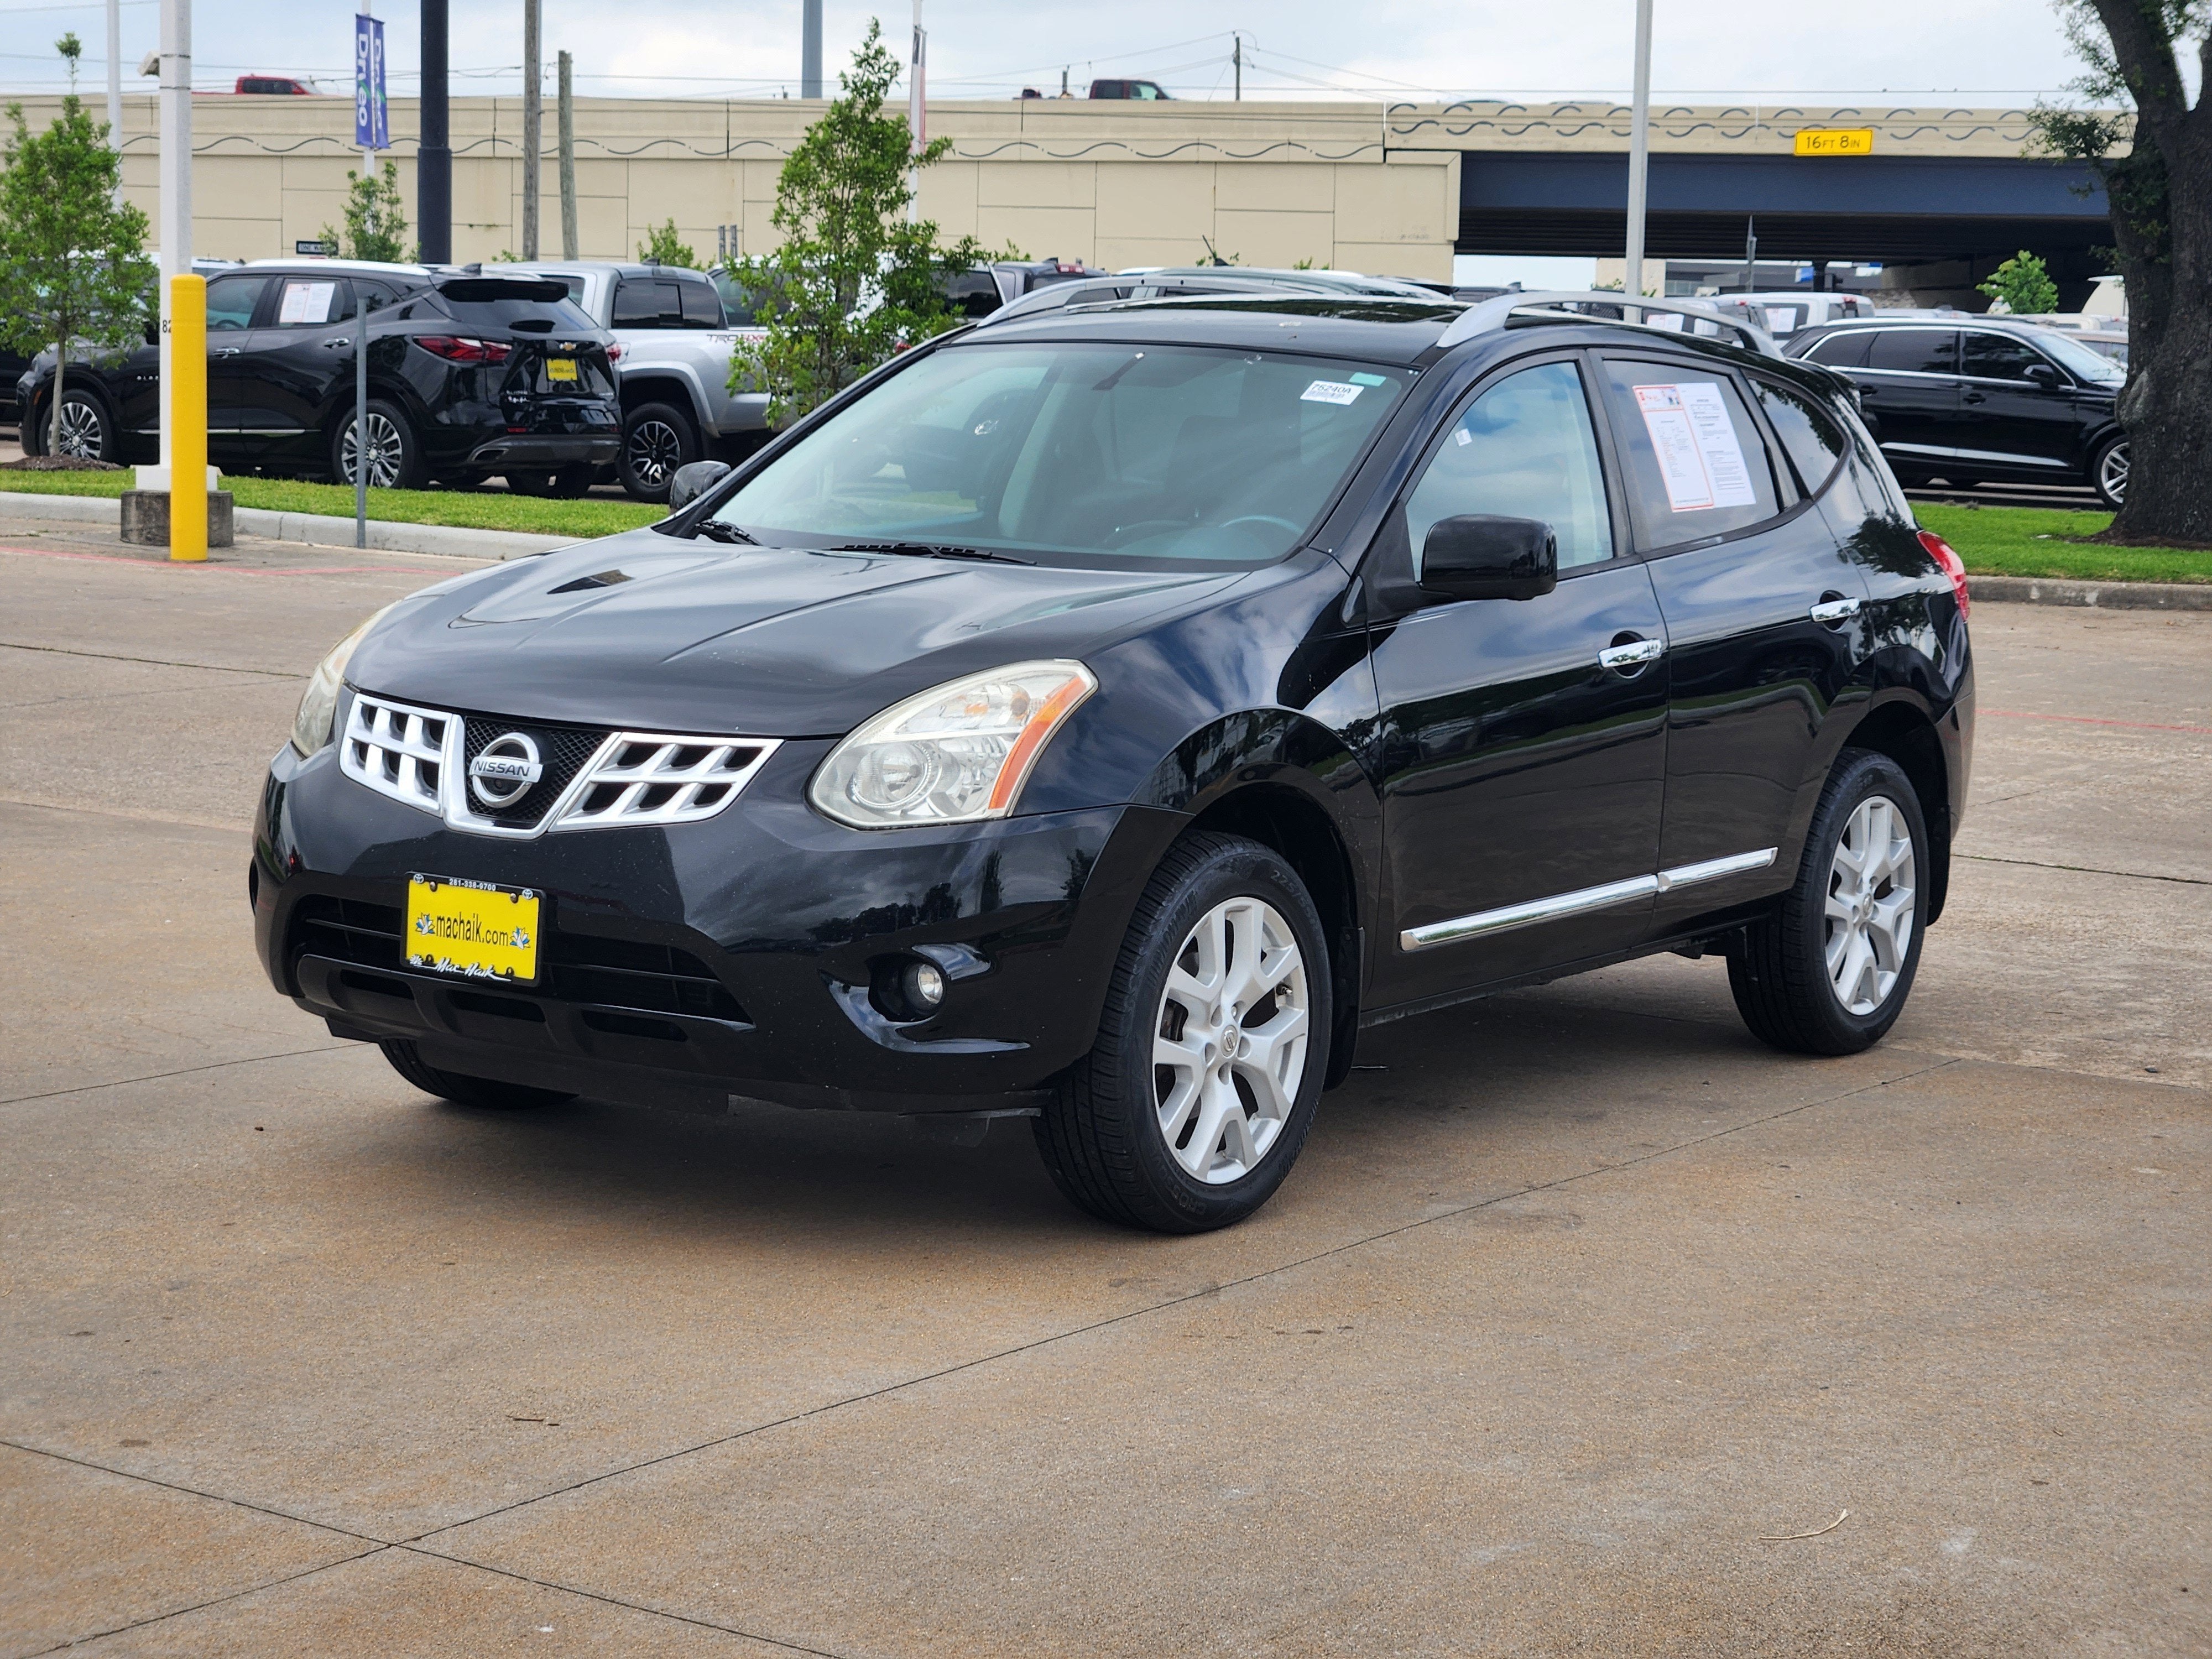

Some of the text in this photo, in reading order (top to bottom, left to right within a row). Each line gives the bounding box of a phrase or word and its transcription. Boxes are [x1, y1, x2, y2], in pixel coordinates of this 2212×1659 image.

[474, 761, 530, 776] NISSAN
[448, 878, 497, 891] 281-338-9700
[436, 911, 509, 947] machaik.com
[434, 957, 507, 982] Mac Haik
